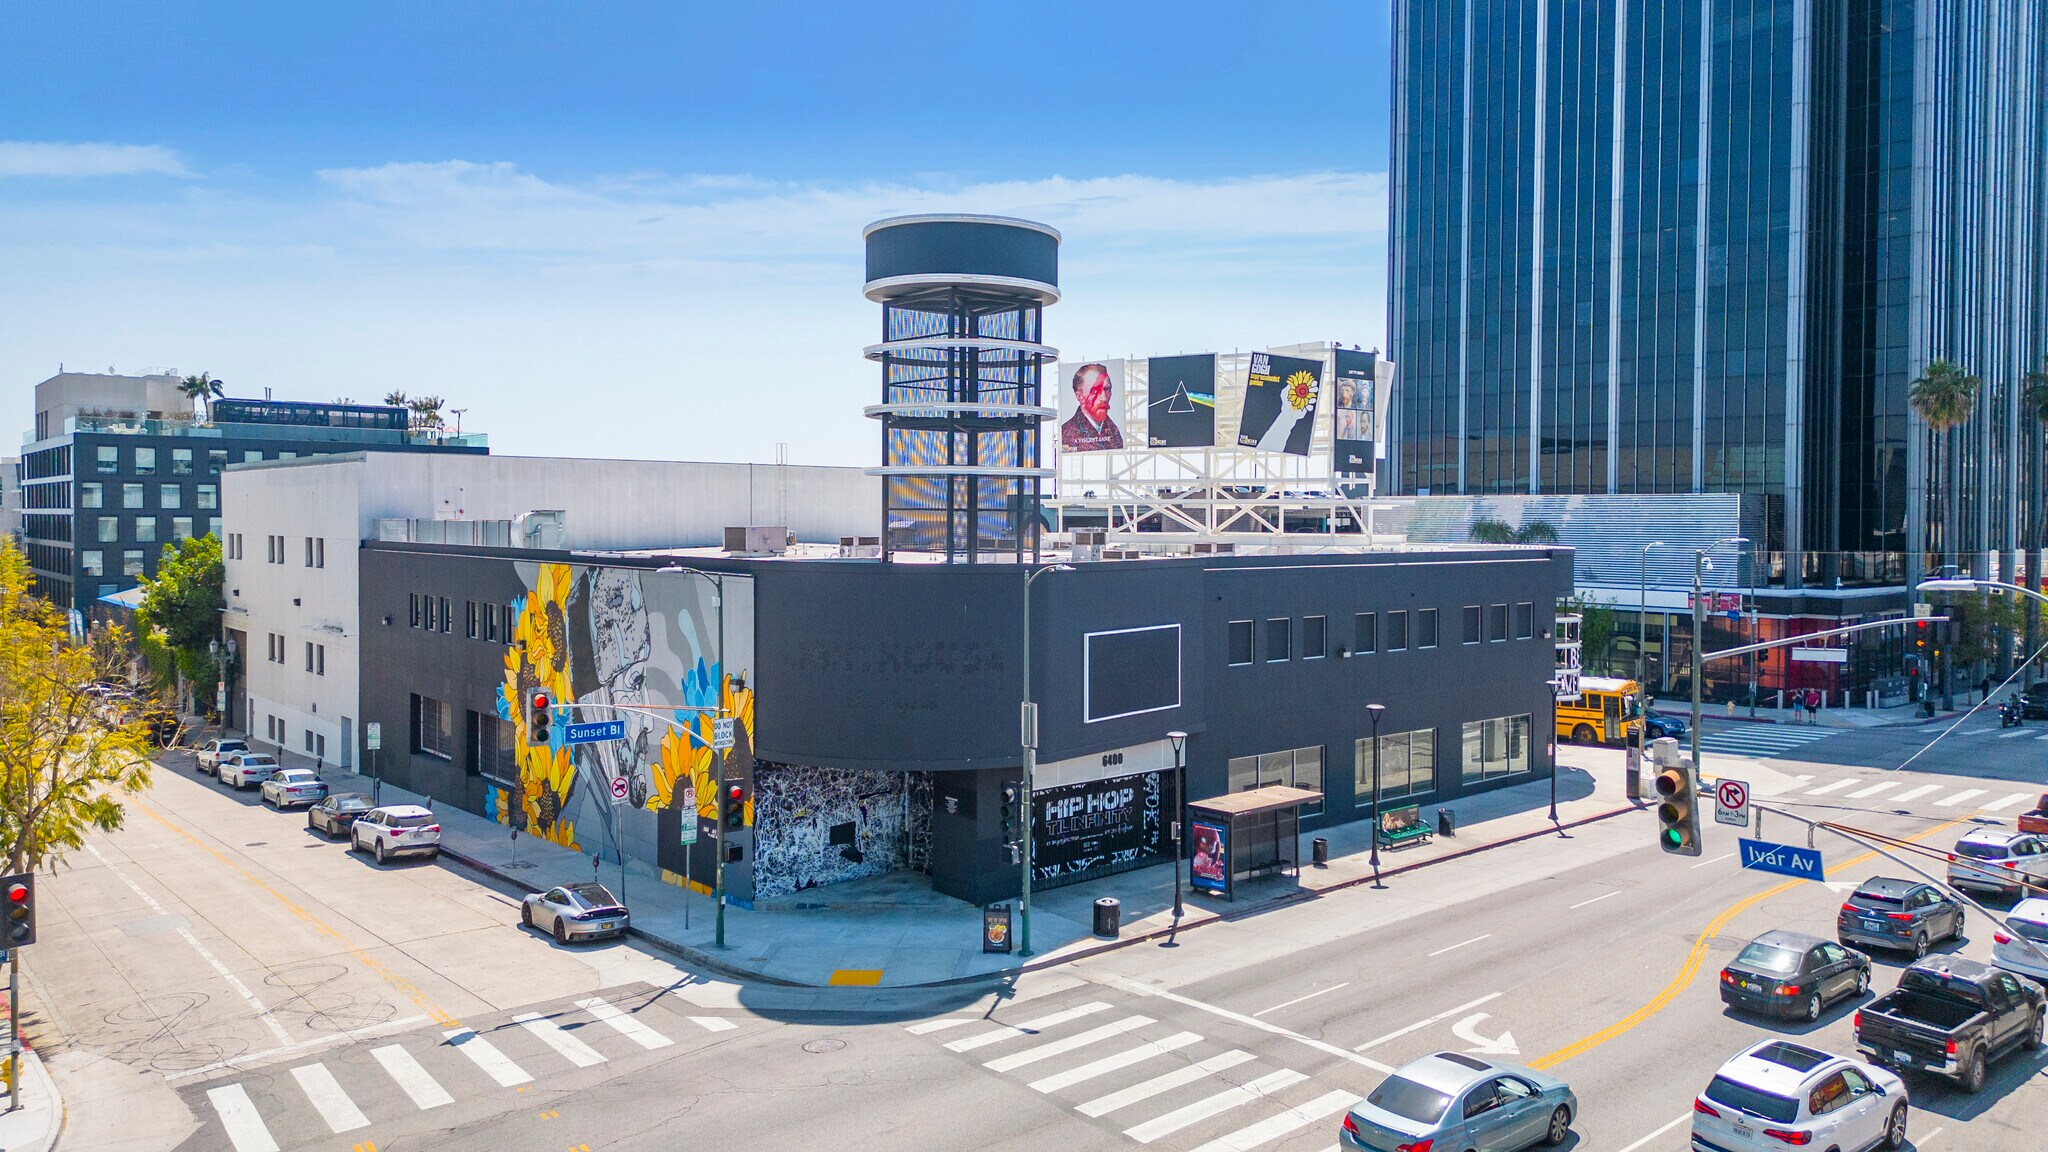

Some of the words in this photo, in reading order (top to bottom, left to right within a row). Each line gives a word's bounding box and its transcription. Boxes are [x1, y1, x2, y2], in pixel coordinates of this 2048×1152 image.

[1253, 353, 1270, 365] VAN
[1251, 363, 1271, 375] GOGH
[570, 726, 607, 739] Sunset
[610, 725, 620, 735] Bl
[714, 722, 721, 730] DO
[723, 721, 733, 729] NOT
[714, 731, 733, 740] BLOCK
[1102, 752, 1123, 767] 6400
[1045, 796, 1084, 822] HIP
[1087, 788, 1135, 814] HOP
[1718, 808, 1729, 816] 6AM
[1734, 810, 1746, 819] 3PM
[1045, 818, 1070, 836] TIL
[1070, 807, 1133, 832] INFINITY
[1748, 846, 1786, 867] Ivar
[1791, 853, 1814, 871] Av
